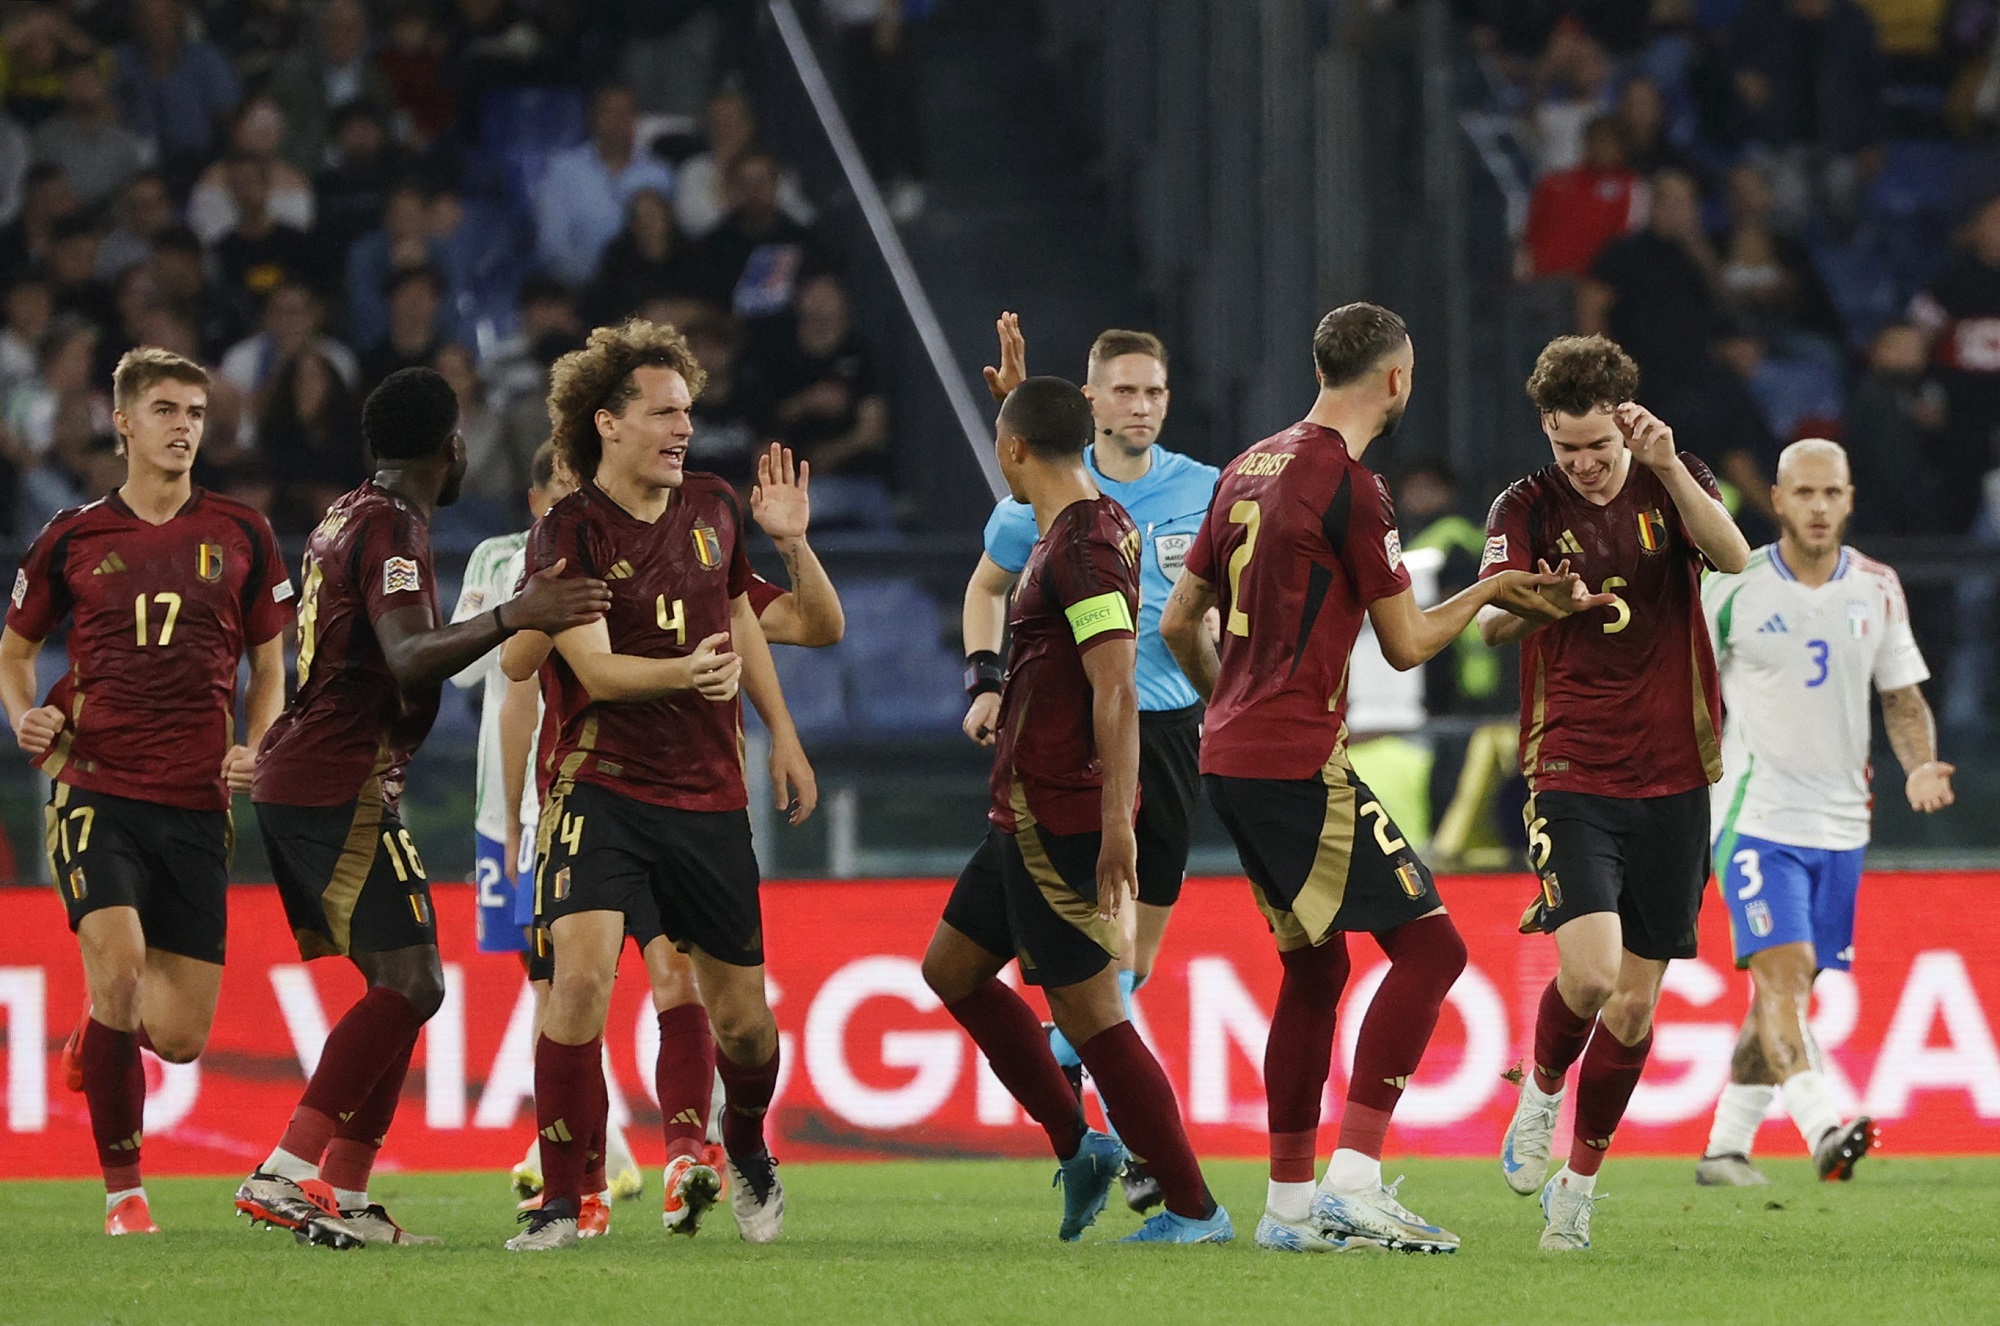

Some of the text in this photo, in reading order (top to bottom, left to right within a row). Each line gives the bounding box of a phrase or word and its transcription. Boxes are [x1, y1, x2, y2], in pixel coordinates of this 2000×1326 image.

[1236, 452, 1296, 476] DEBAST
[1226, 500, 1261, 638] 2
[135, 592, 182, 646] 17
[656, 593, 686, 646] 4
[1075, 608, 1112, 628] RESPECT
[1602, 576, 1631, 634] 5
[1806, 638, 1829, 687] 3
[60, 805, 95, 864] 17
[382, 828, 427, 882] 18
[560, 811, 585, 856] 4
[1359, 800, 1407, 856] 2
[1529, 817, 1552, 871] 5
[1733, 848, 1764, 900] 3
